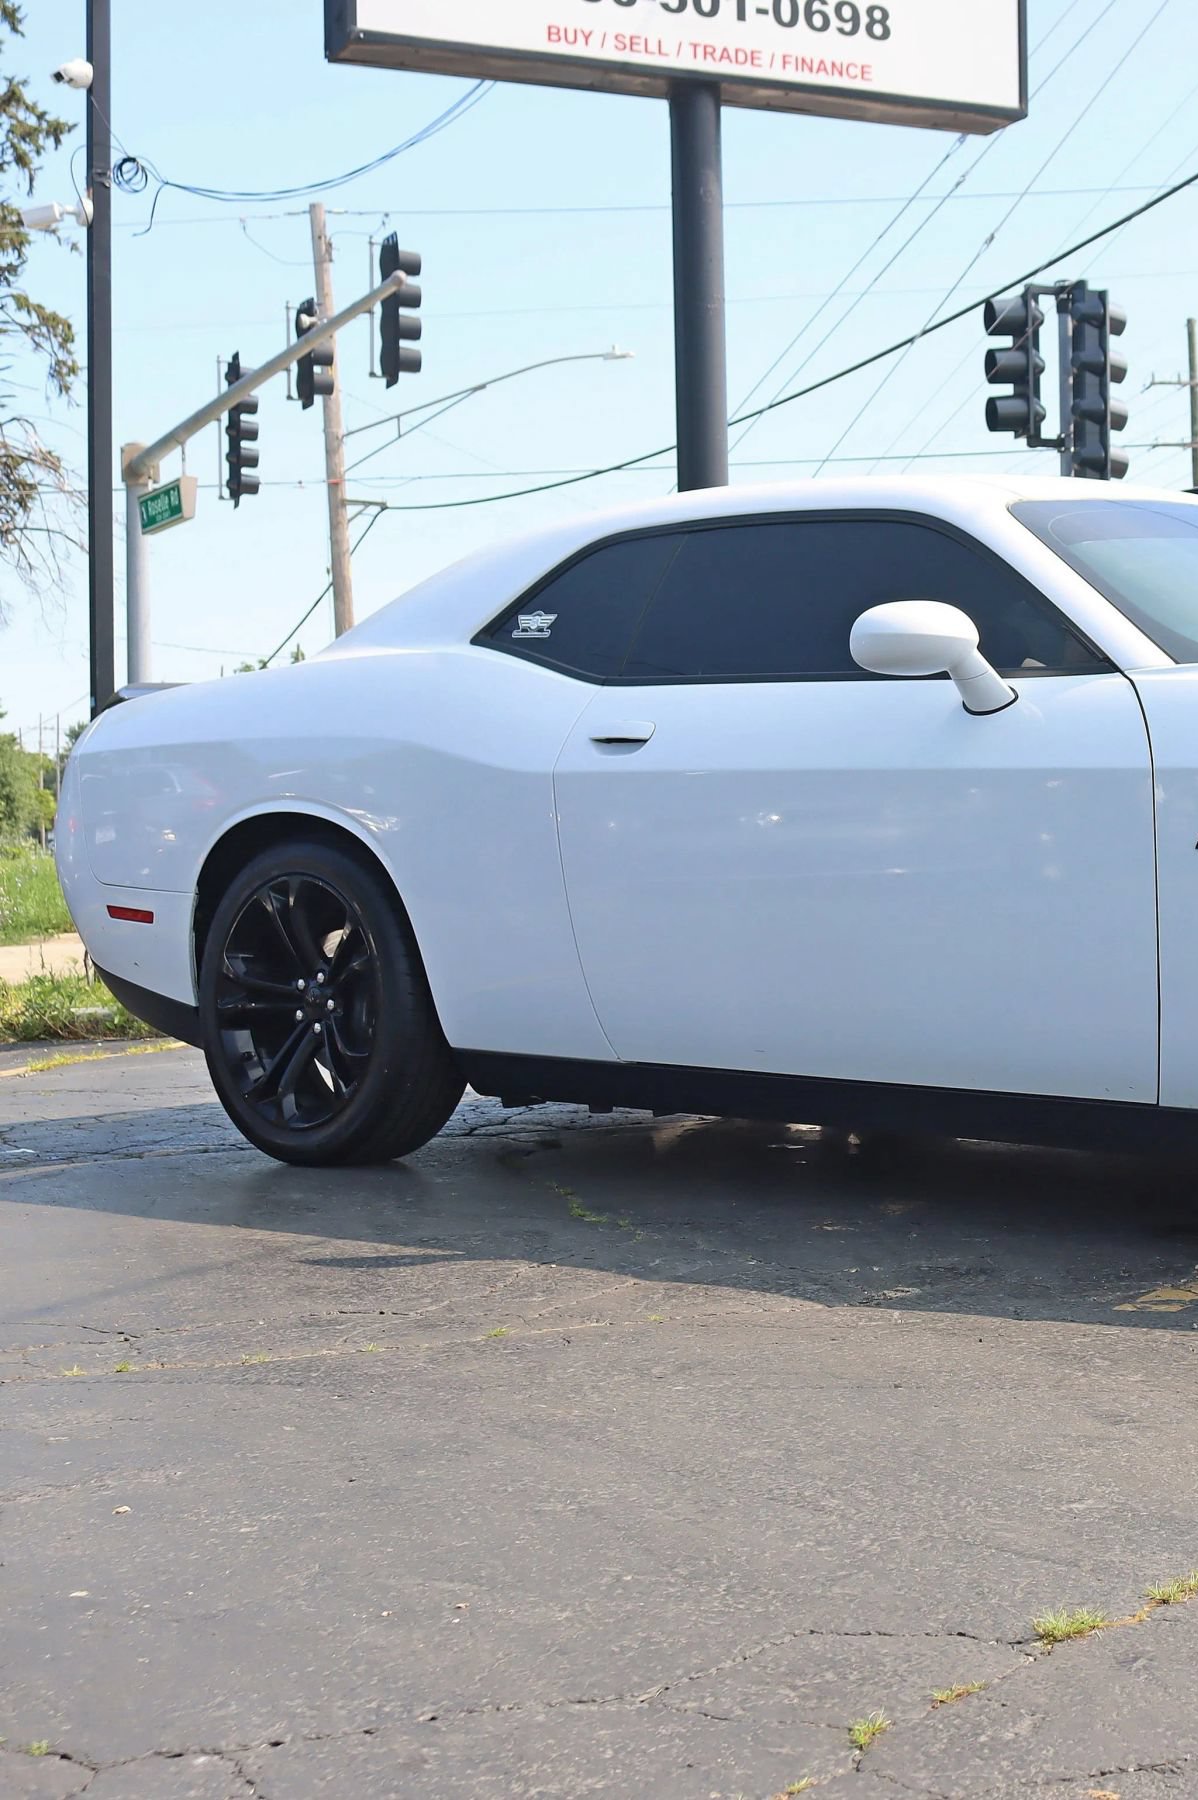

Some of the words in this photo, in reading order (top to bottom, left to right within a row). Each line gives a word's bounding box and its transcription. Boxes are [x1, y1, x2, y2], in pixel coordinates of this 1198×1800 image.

[547, 25, 593, 46] BUY
[601, 31, 607, 49] /
[614, 34, 670, 57] SELL
[676, 41, 682, 57] /
[689, 42, 763, 67] TRADE
[769, 52, 775, 69] /
[782, 54, 873, 81] FINANCE
[170, 486, 179, 506] Rd
